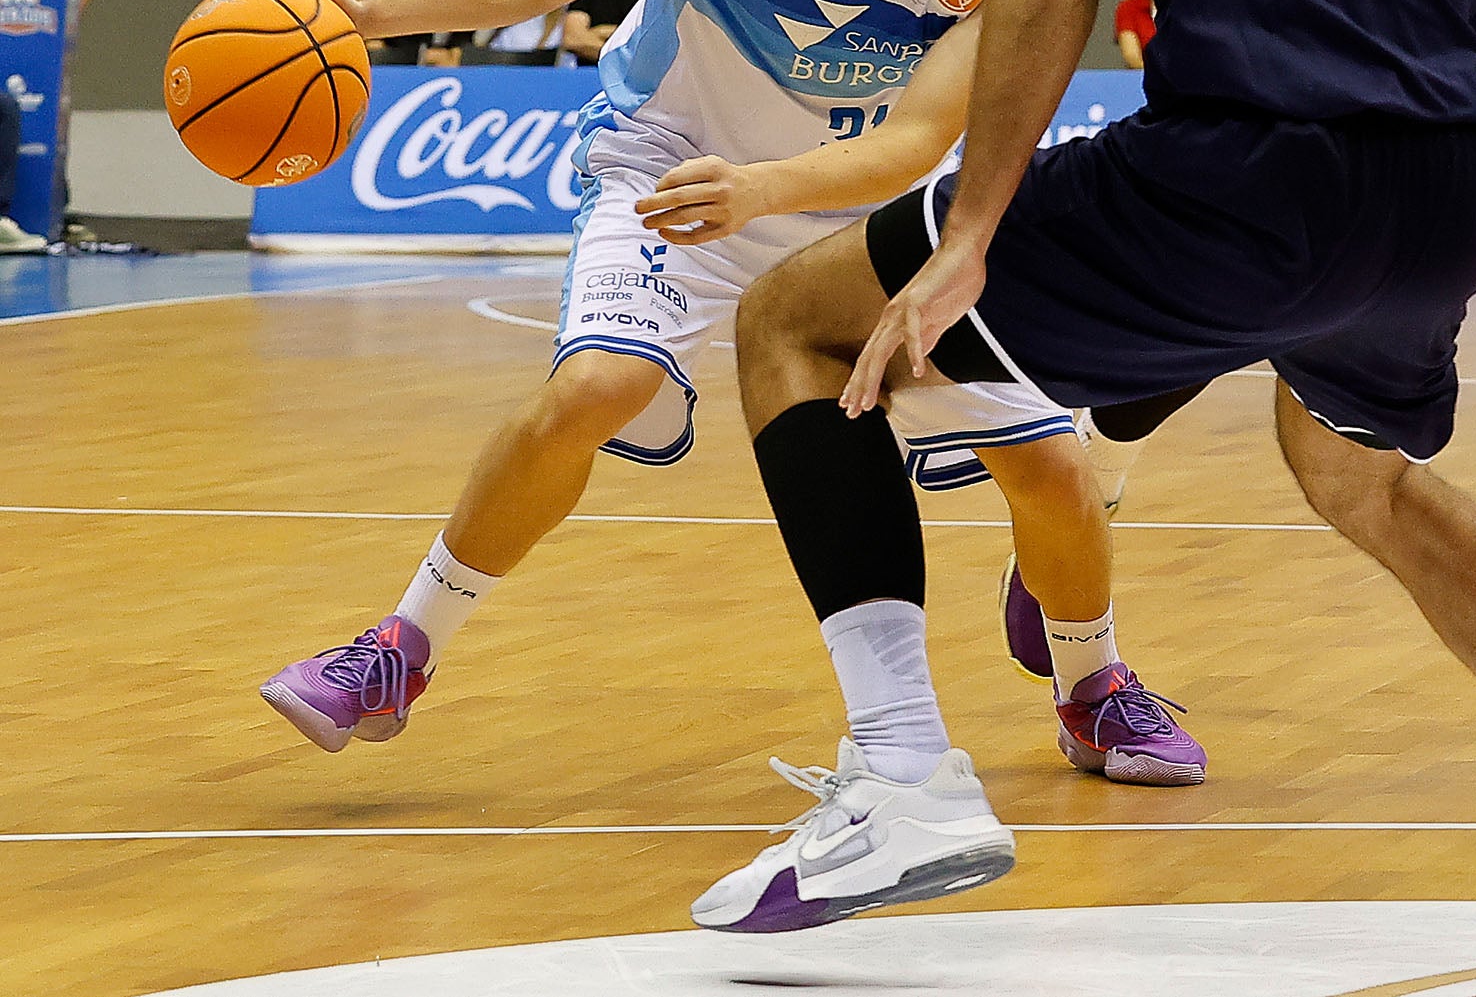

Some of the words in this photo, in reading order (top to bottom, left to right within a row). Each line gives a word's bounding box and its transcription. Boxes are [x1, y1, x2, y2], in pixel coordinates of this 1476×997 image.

[581, 291, 633, 303] Burgos
[586, 268, 688, 315] cajarural
[580, 312, 660, 334] GIVOVA
[427, 562, 477, 600] OVA
[1051, 620, 1114, 643] GIVO
